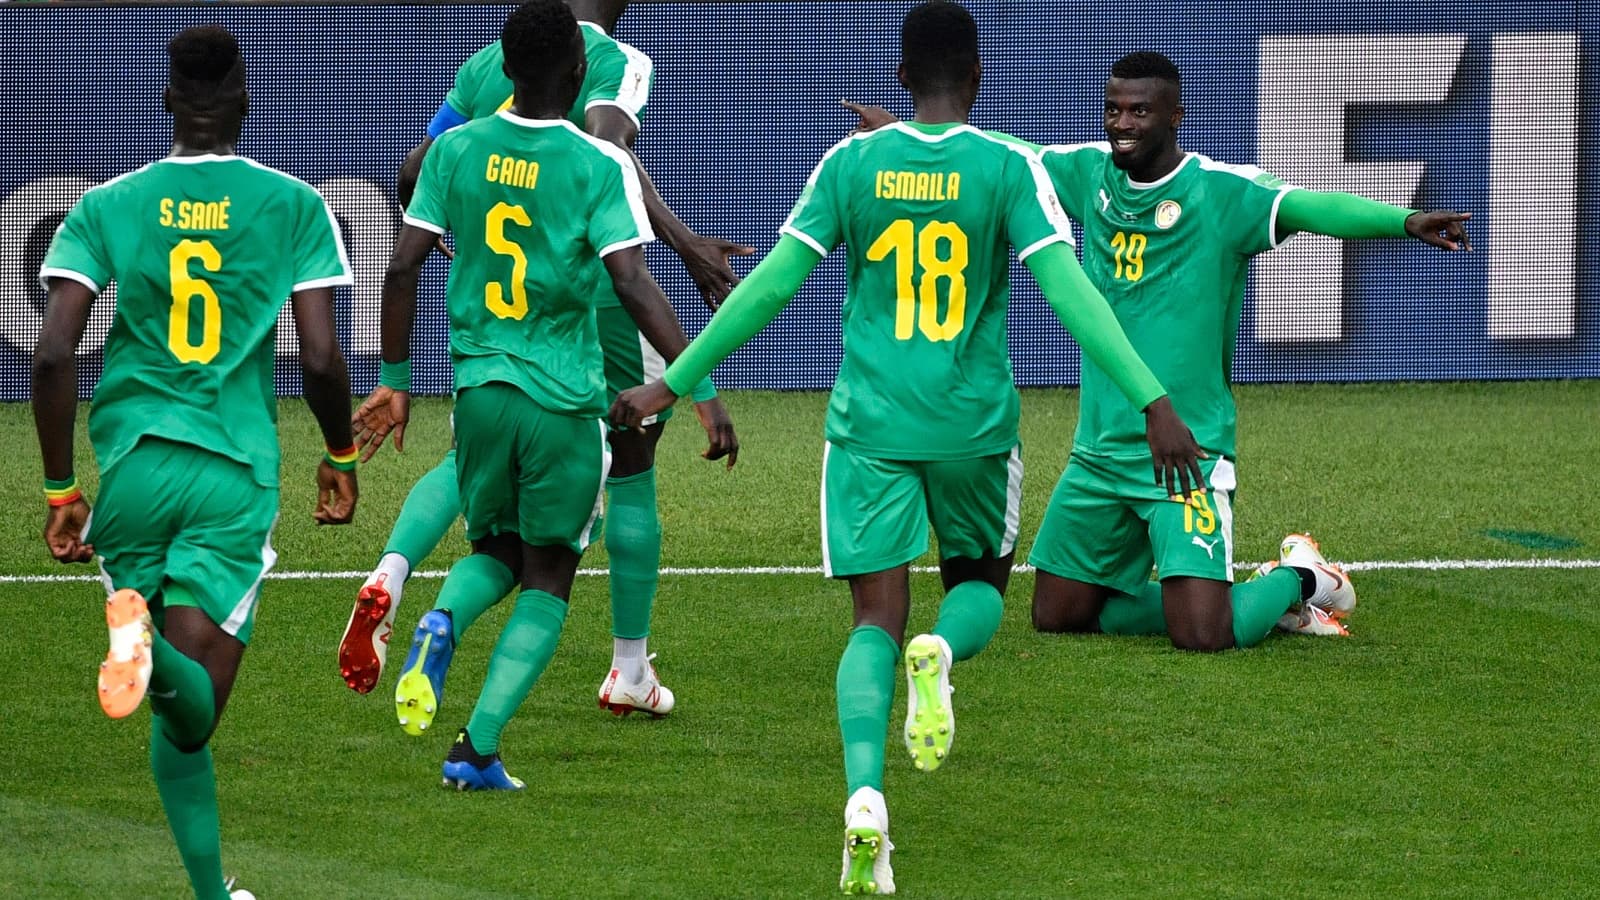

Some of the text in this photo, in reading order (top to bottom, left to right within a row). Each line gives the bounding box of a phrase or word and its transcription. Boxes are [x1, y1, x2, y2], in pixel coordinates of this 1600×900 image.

[485, 153, 539, 190] GANA
[875, 170, 961, 201] ISMAILA
[159, 196, 231, 230] S.SANÉ
[485, 201, 532, 321] 5
[866, 219, 969, 342] 18
[1110, 231, 1147, 282] 19
[168, 239, 222, 364] 6
[1174, 488, 1216, 535] 19
